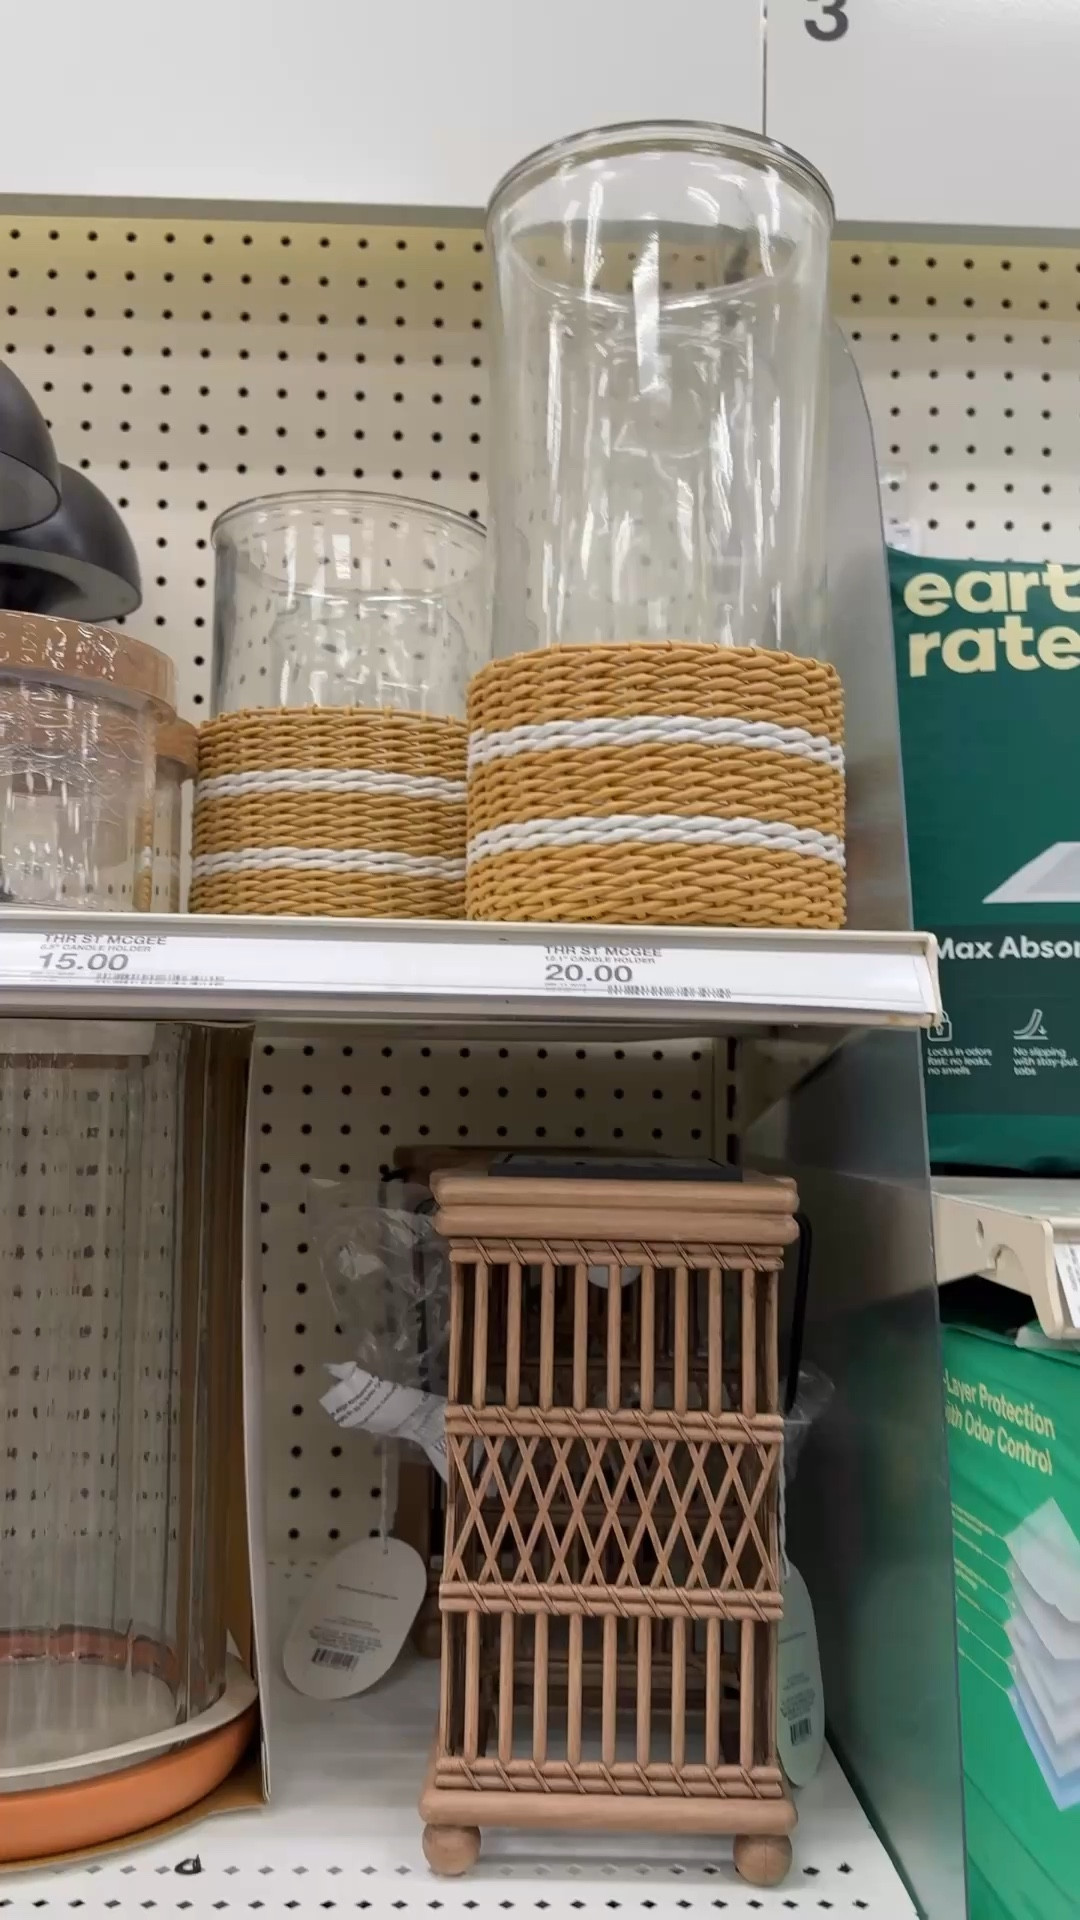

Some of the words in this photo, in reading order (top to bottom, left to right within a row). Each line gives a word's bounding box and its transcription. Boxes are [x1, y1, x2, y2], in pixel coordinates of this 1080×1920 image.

[804, 0, 849, 42] 3
[45, 933, 77, 943] THR
[82, 934, 101, 944] ST
[107, 935, 168, 945] MCGEE
[545, 946, 577, 955] THR
[580, 946, 600, 955] ST
[605, 947, 663, 957] MCGEE
[937, 937, 993, 960] Max
[39, 953, 129, 971] 15.00
[545, 964, 633, 982] 20.00
[927, 1047, 953, 1057] Locks
[954, 1047, 965, 1057] in
[965, 1047, 993, 1057] odors
[1013, 1047, 1028, 1057] No
[1029, 1046, 1067, 1059] slipping
[1013, 1057, 1036, 1067] with
[1037, 1057, 1079, 1069] stay-put
[927, 1067, 941, 1076] no
[1013, 1066, 1037, 1076] tabs
[979, 1382, 1056, 1441] Protection
[965, 1409, 996, 1448] Odor
[997, 1426, 1053, 1477] Control
